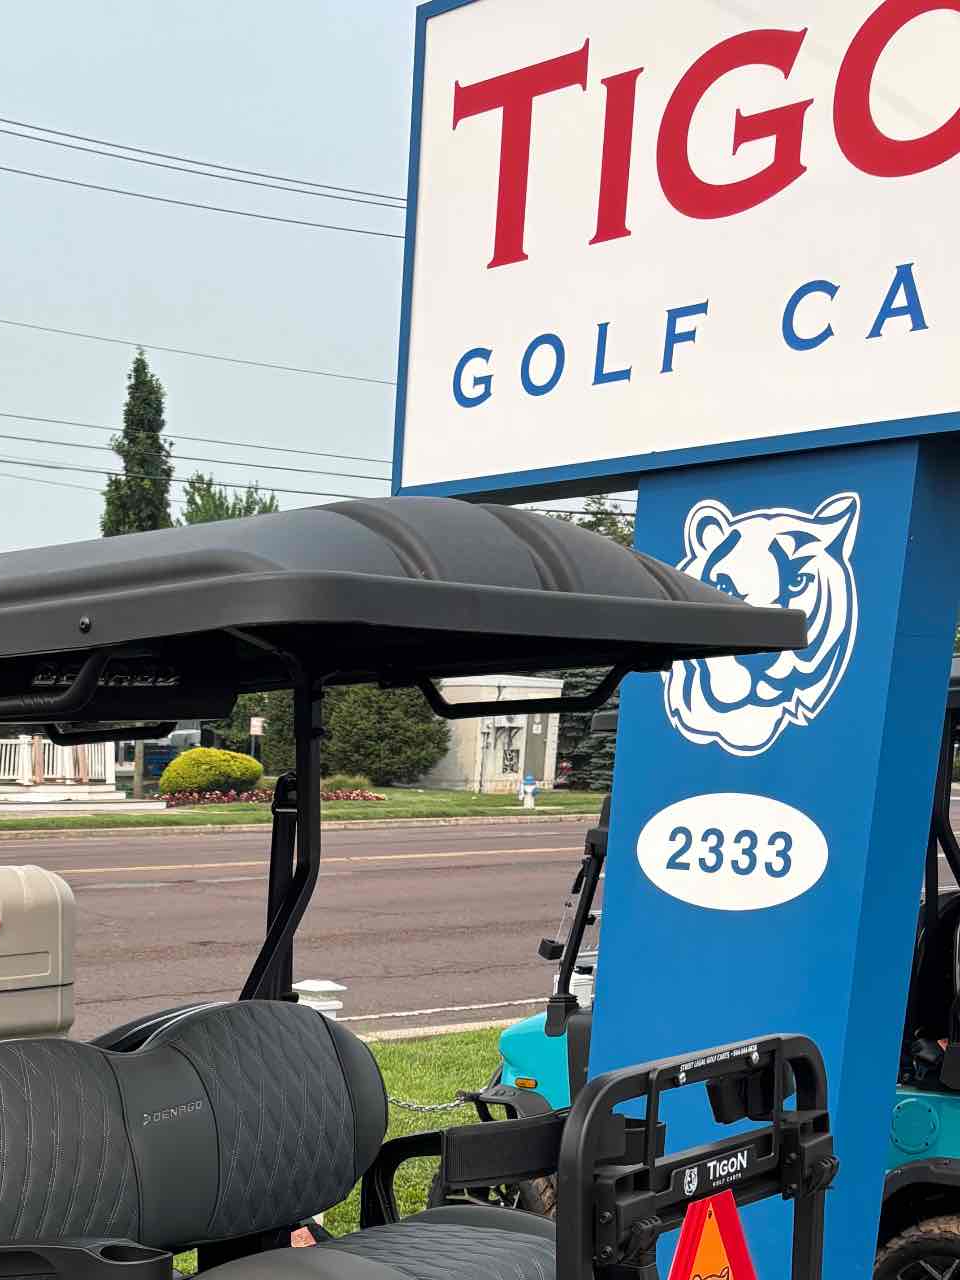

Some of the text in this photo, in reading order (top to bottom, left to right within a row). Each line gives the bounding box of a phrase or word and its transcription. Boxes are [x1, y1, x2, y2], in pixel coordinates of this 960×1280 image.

[452, 0, 960, 269] TIGO
[452, 262, 929, 408] GOLF CA
[666, 826, 793, 878] 2333
[707, 1150, 748, 1180] TIGON
